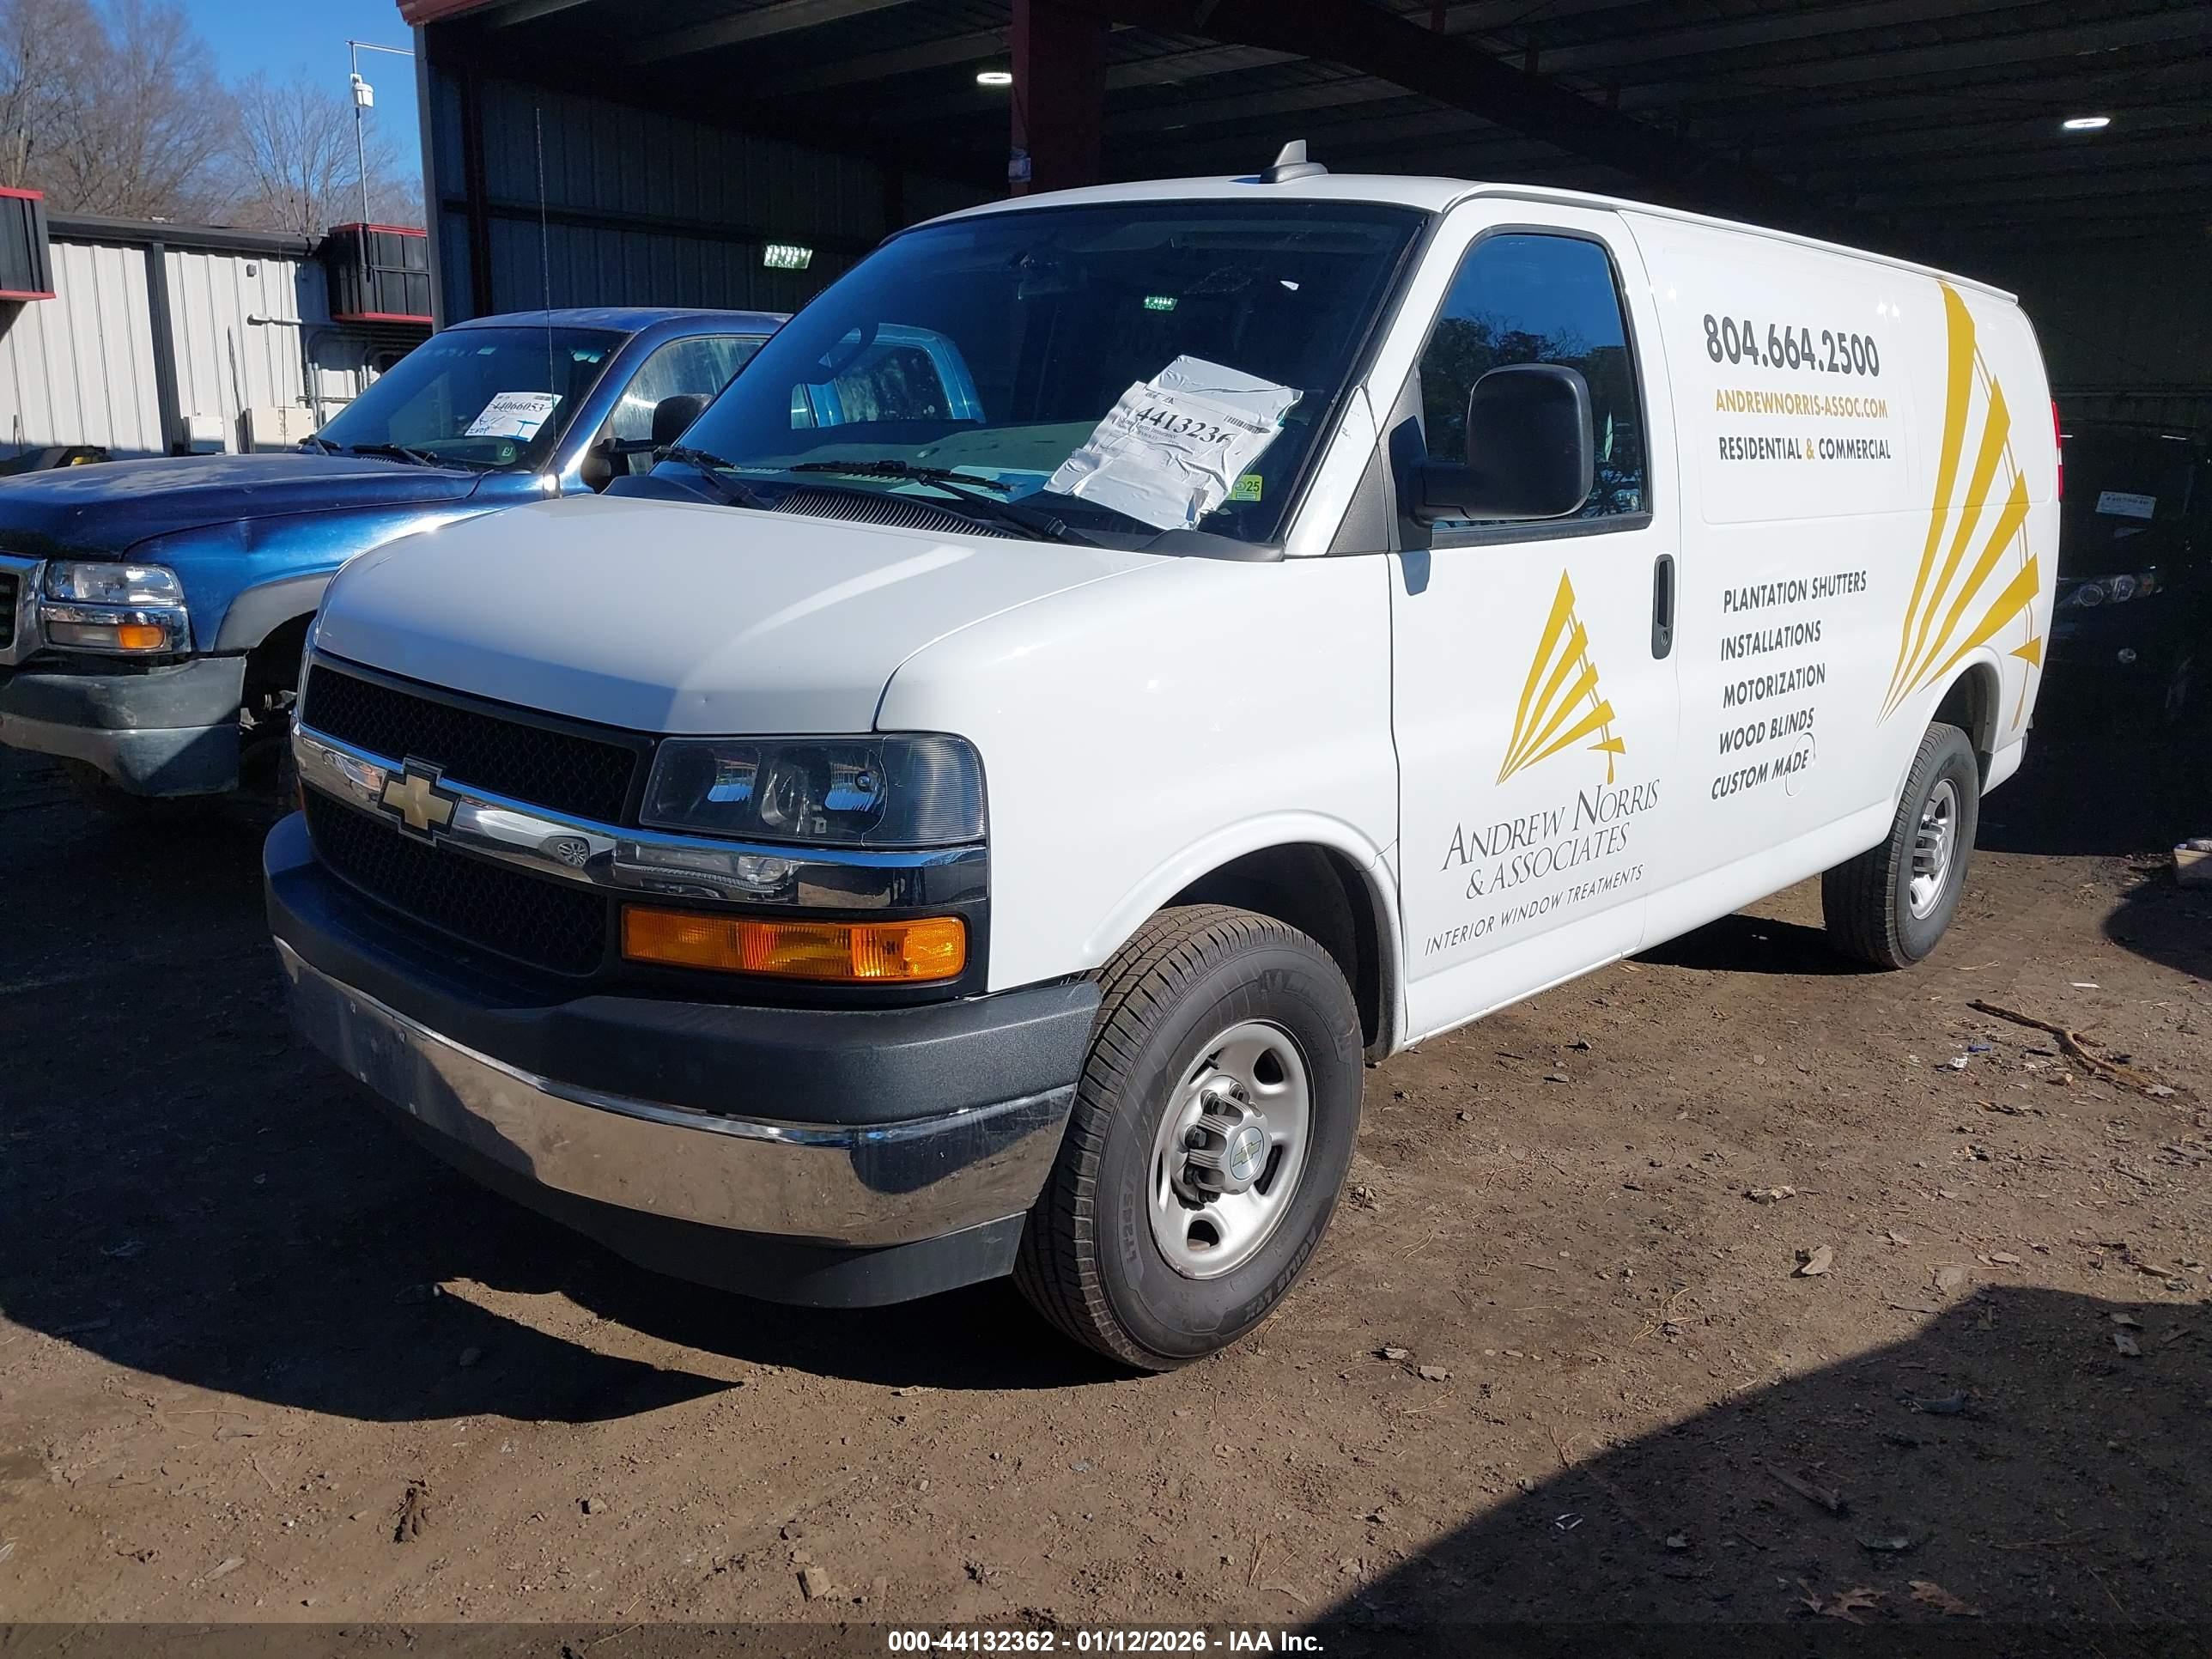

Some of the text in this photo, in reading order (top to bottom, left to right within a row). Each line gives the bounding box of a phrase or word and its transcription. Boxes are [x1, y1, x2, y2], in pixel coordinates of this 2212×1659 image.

[1704, 314, 1880, 377] 804.664.2500
[1717, 389, 1888, 419] ANDREWNORRIS-ASSOC.COM
[1719, 436, 1892, 460] RESIDENTIAL & COMMERCIAL
[1246, 481, 1261, 492] 25
[1723, 569, 1867, 614] PLANTATION SHUTTERS
[1721, 620, 1821, 661] INSTALLATIONS
[1723, 663, 1826, 709] MOTORIZATION
[1719, 707, 1815, 756] WOOD BLINDS
[1711, 749, 1809, 800] CUSTOM MADE
[1439, 779, 1660, 872] ANDREW NORRIS
[1466, 822, 1630, 900] & ASSOCIATES
[1425, 864, 1644, 957] INTERIOR WINDOW TREATMENTS
